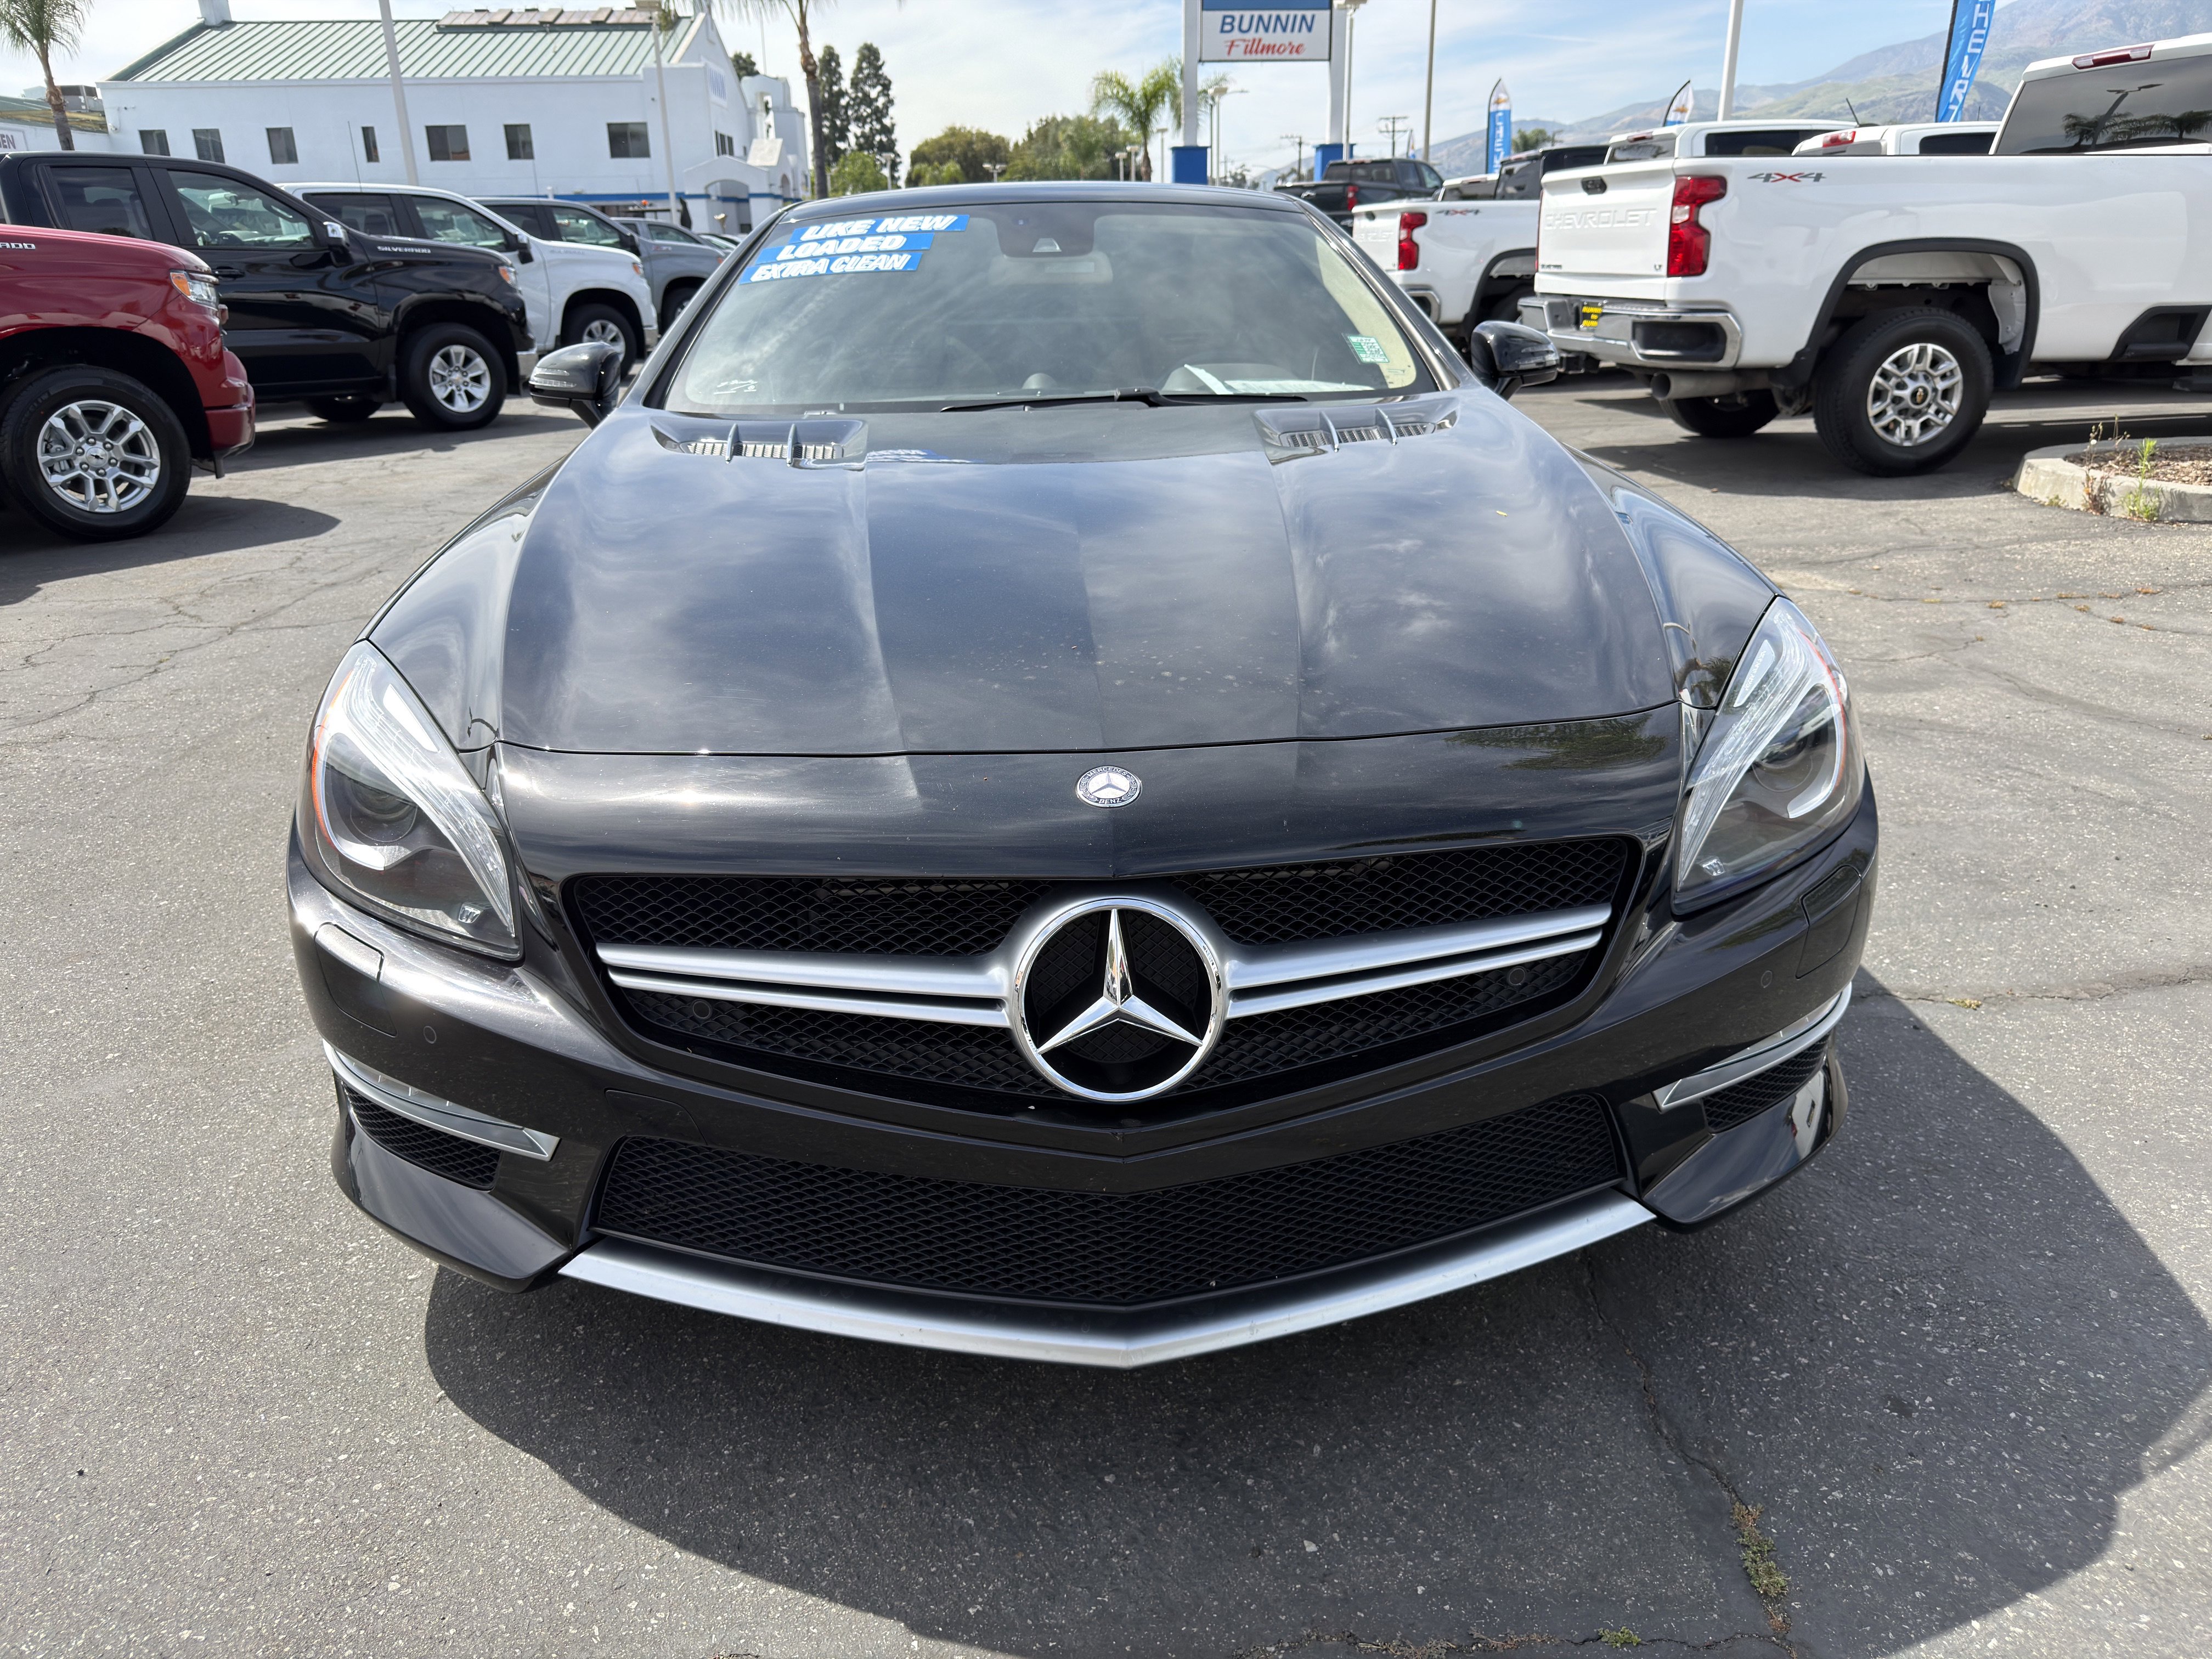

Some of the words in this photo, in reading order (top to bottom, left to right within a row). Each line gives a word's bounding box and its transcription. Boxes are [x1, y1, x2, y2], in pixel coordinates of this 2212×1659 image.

[1220, 14, 1316, 33] BUNNIN
[1224, 37, 1306, 57] Fillmore
[1949, 0, 1990, 110] HEVR
[0, 133, 16, 149] EN
[799, 219, 876, 241] LIKE
[876, 215, 958, 233] NEW
[1544, 207, 1657, 230] CHEVROLET
[776, 234, 907, 261] LOADED
[750, 257, 830, 282] EXTRA
[830, 253, 912, 272] CLEAN
[1087, 767, 1128, 777] MERCEDES
